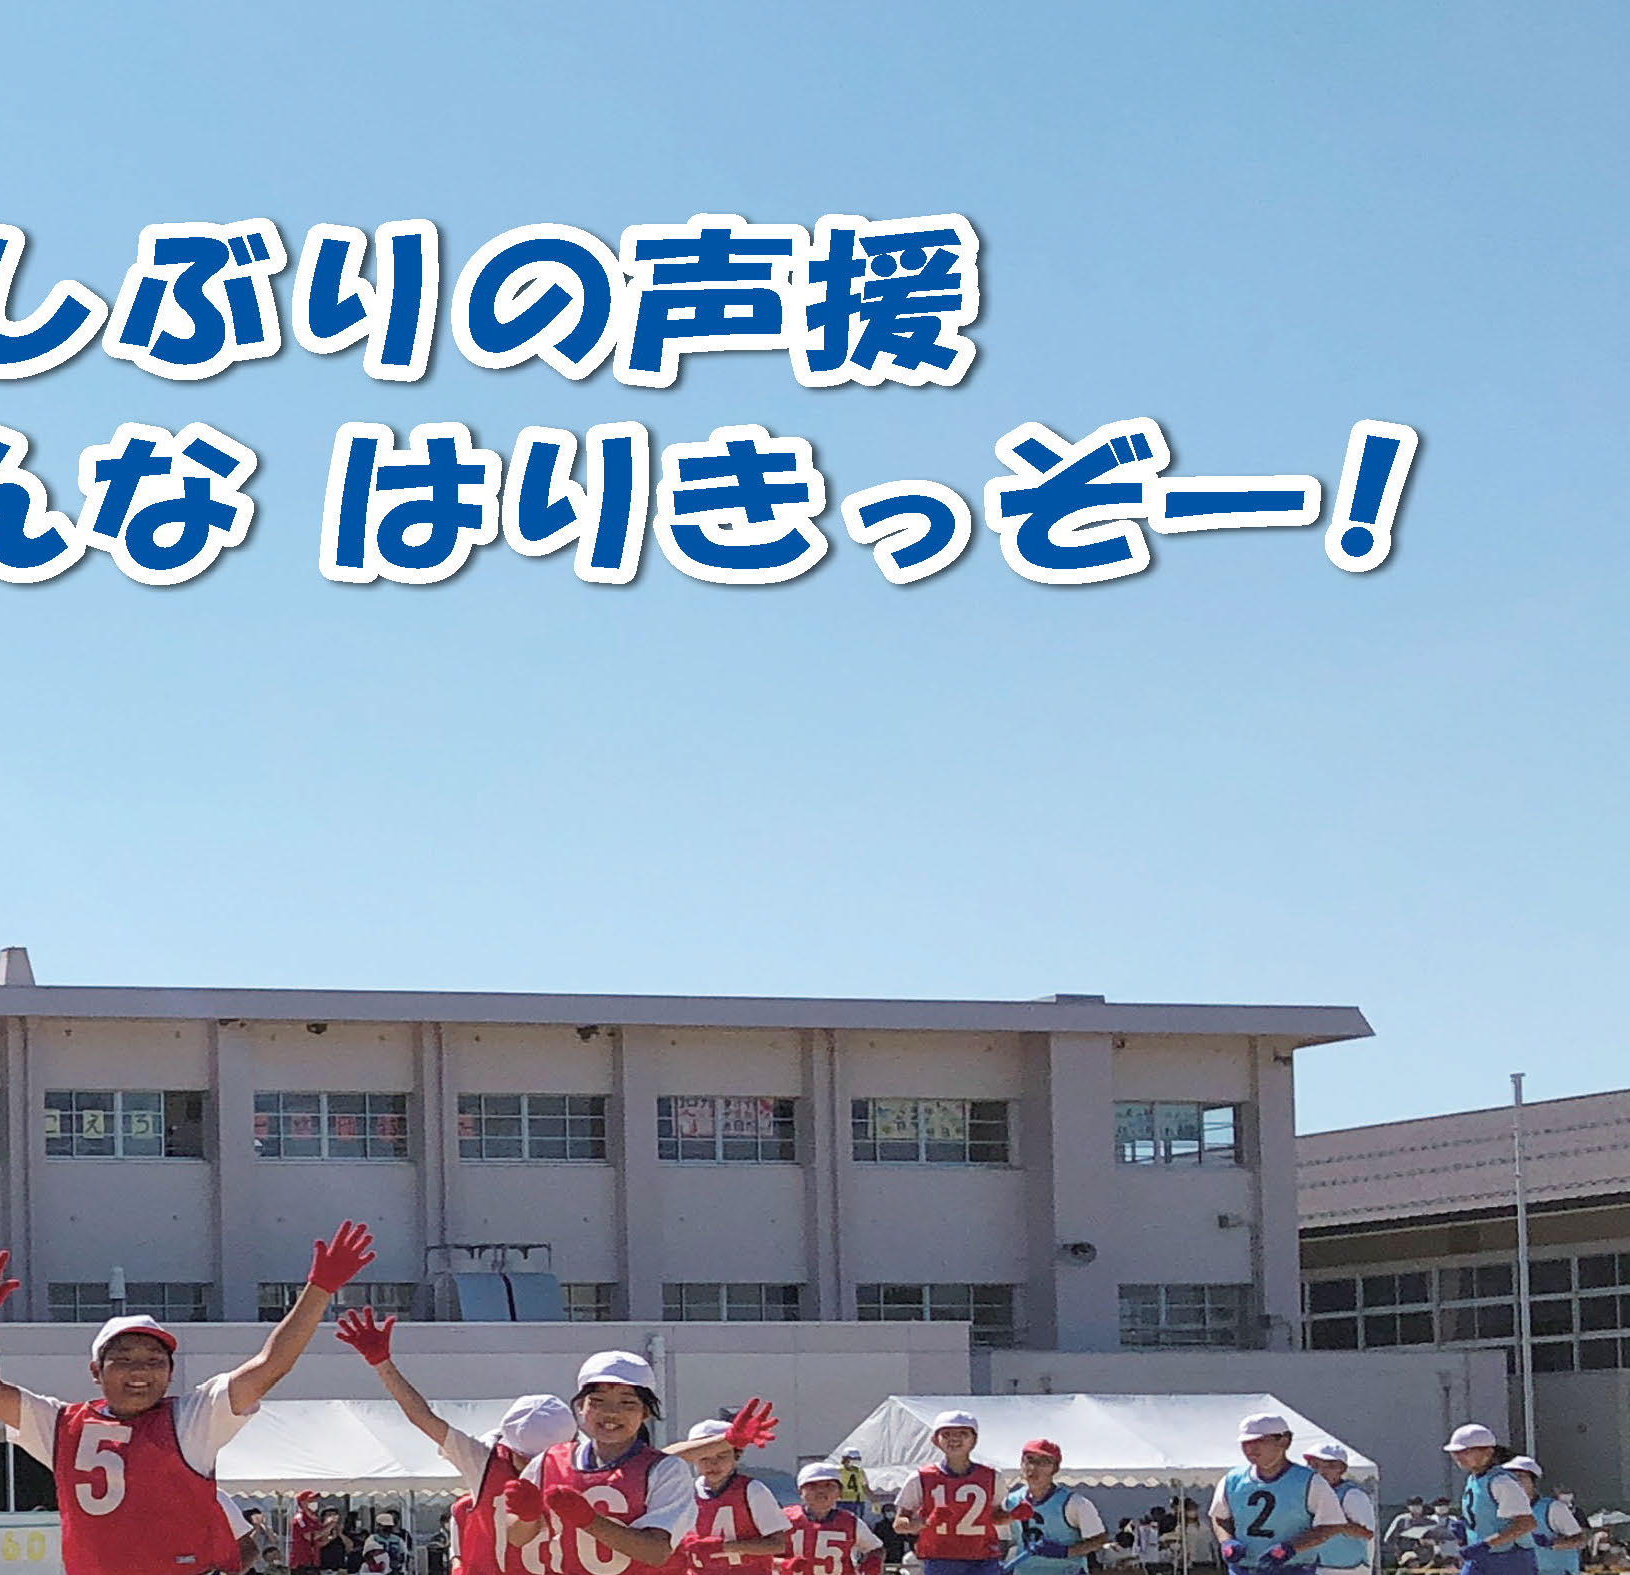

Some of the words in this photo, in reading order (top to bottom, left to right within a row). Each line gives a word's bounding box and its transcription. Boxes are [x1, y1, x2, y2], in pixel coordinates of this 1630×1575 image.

[74, 1422, 133, 1517] 5
[847, 1474, 858, 1492] 4
[931, 1484, 987, 1535] 12
[1246, 1490, 1276, 1538] 2
[1, 1530, 46, 1561] 60
[691, 1506, 743, 1568] 4
